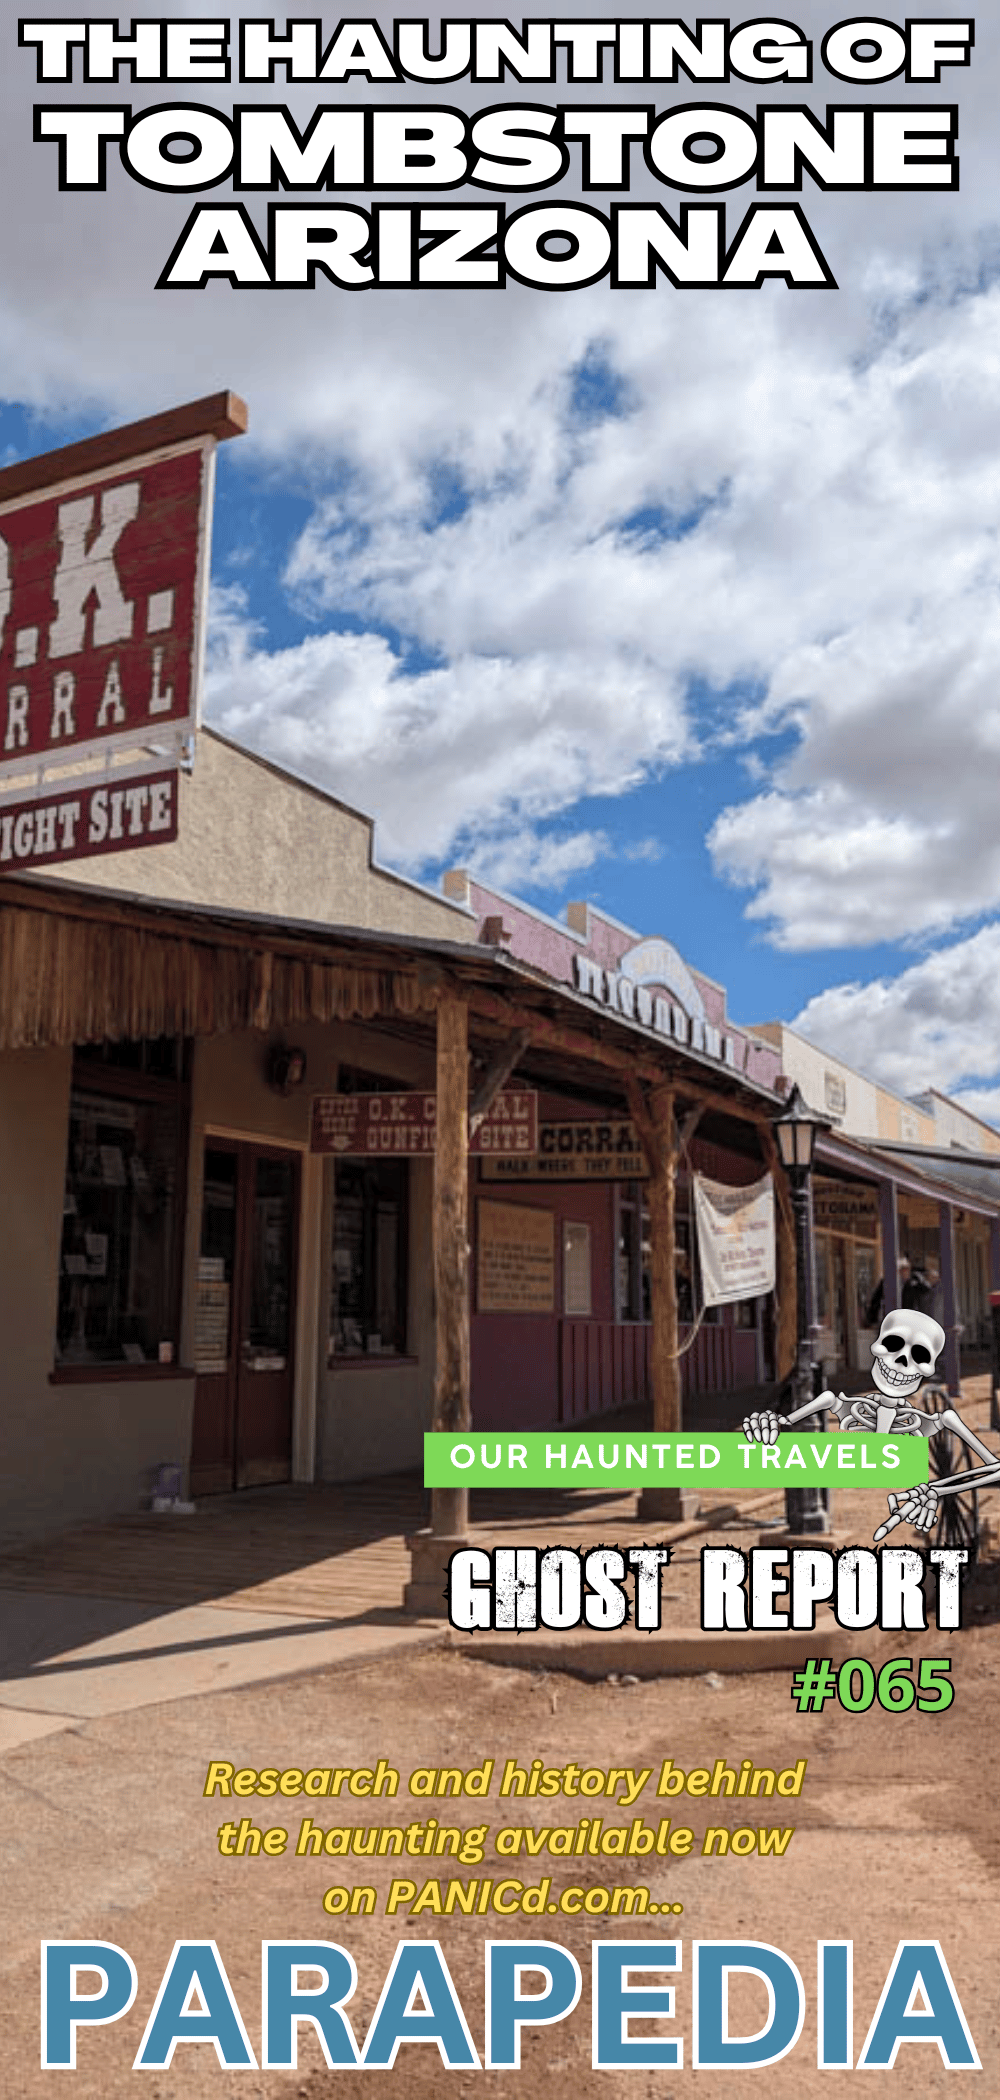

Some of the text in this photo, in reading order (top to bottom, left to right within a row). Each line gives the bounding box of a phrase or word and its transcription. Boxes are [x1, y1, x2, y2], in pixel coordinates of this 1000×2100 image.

[0, 781, 172, 862] IGHT SITE
[368, 1096, 529, 1121] O.K. CAL
[480, 1125, 529, 1149] SITE
